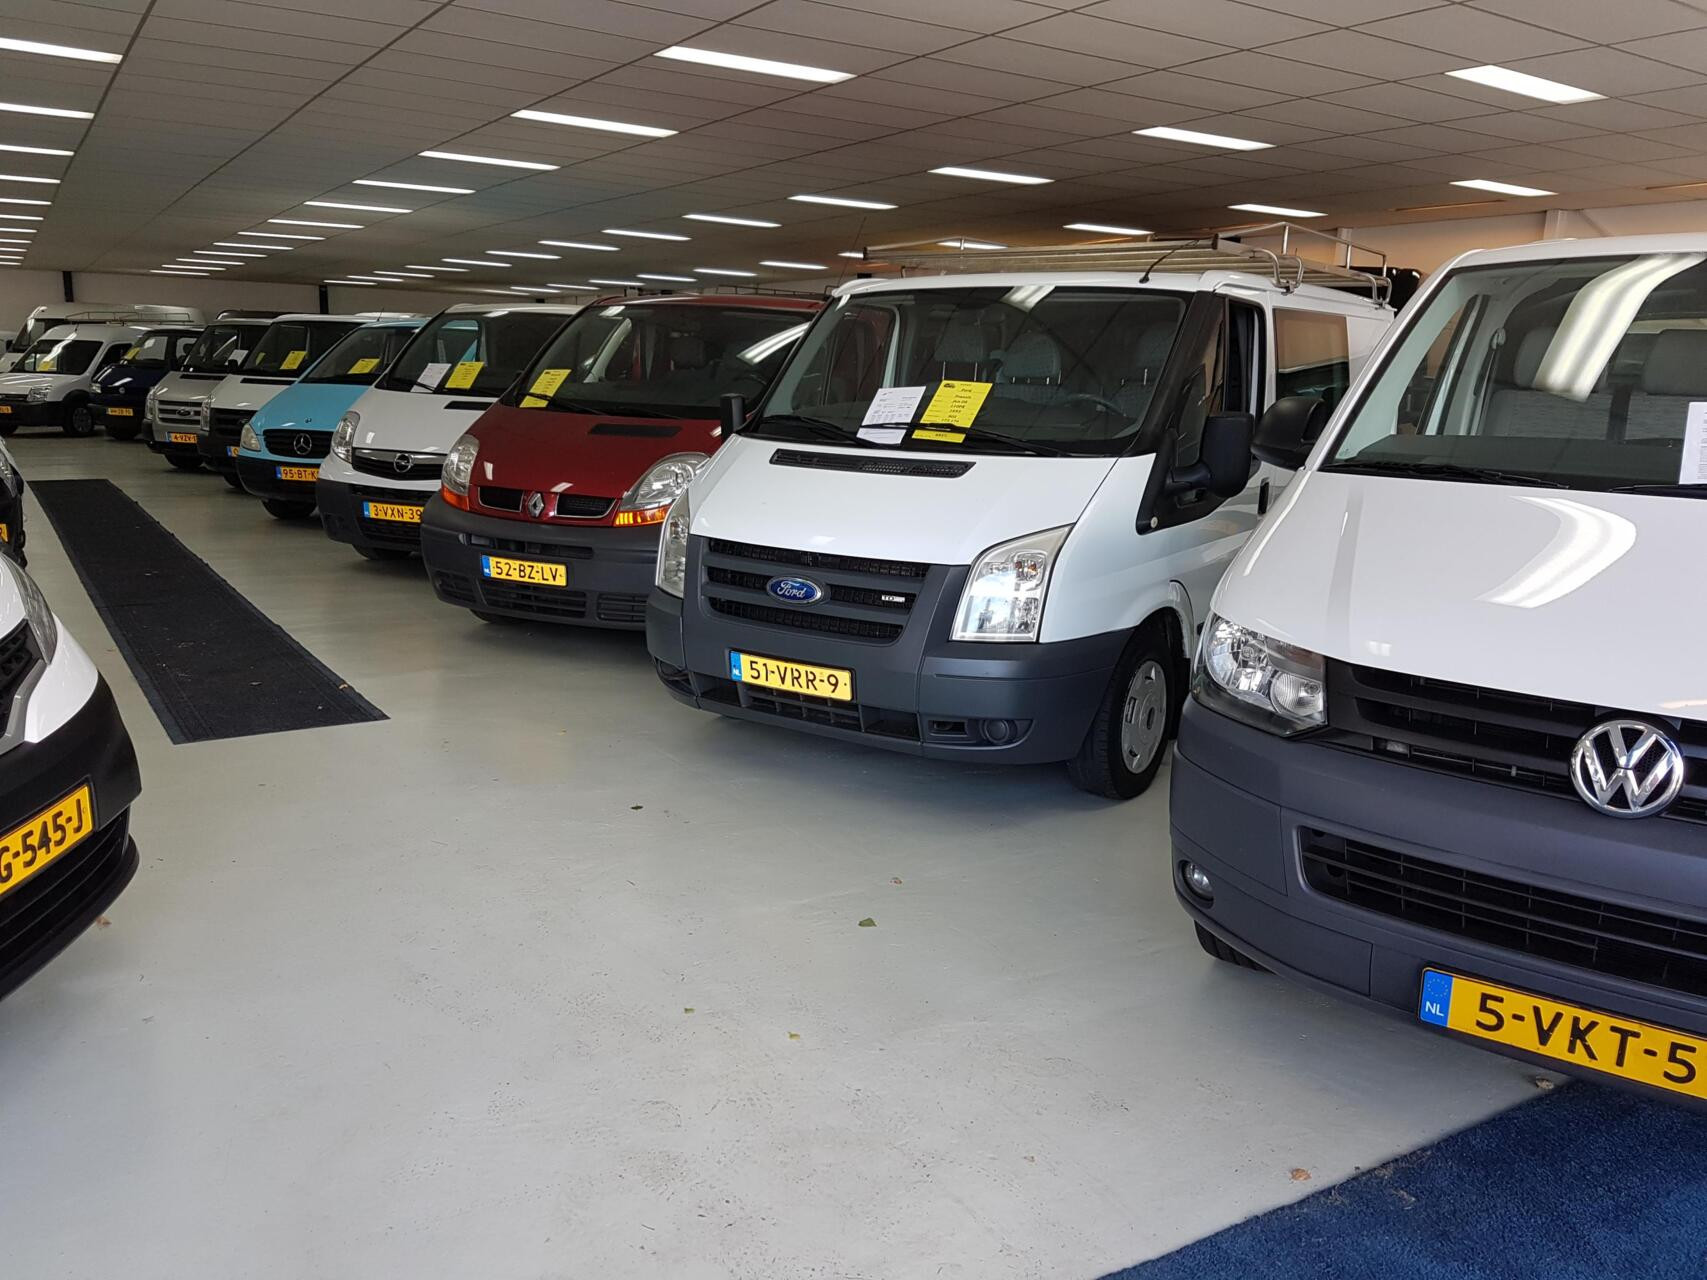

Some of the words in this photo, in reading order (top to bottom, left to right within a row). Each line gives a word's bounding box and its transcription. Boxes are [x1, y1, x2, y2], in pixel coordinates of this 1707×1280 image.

[282, 468, 319, 481] 95-BT-K
[373, 504, 422, 520] 3-VXN-39
[495, 560, 558, 582] 52-BZ-LV
[776, 578, 807, 599] Ford
[749, 660, 839, 694] 51-VRR-9
[0, 798, 84, 884] G-545-J
[1424, 1001, 1445, 1018] NL
[1475, 991, 1698, 1085] 5-VKT-5
